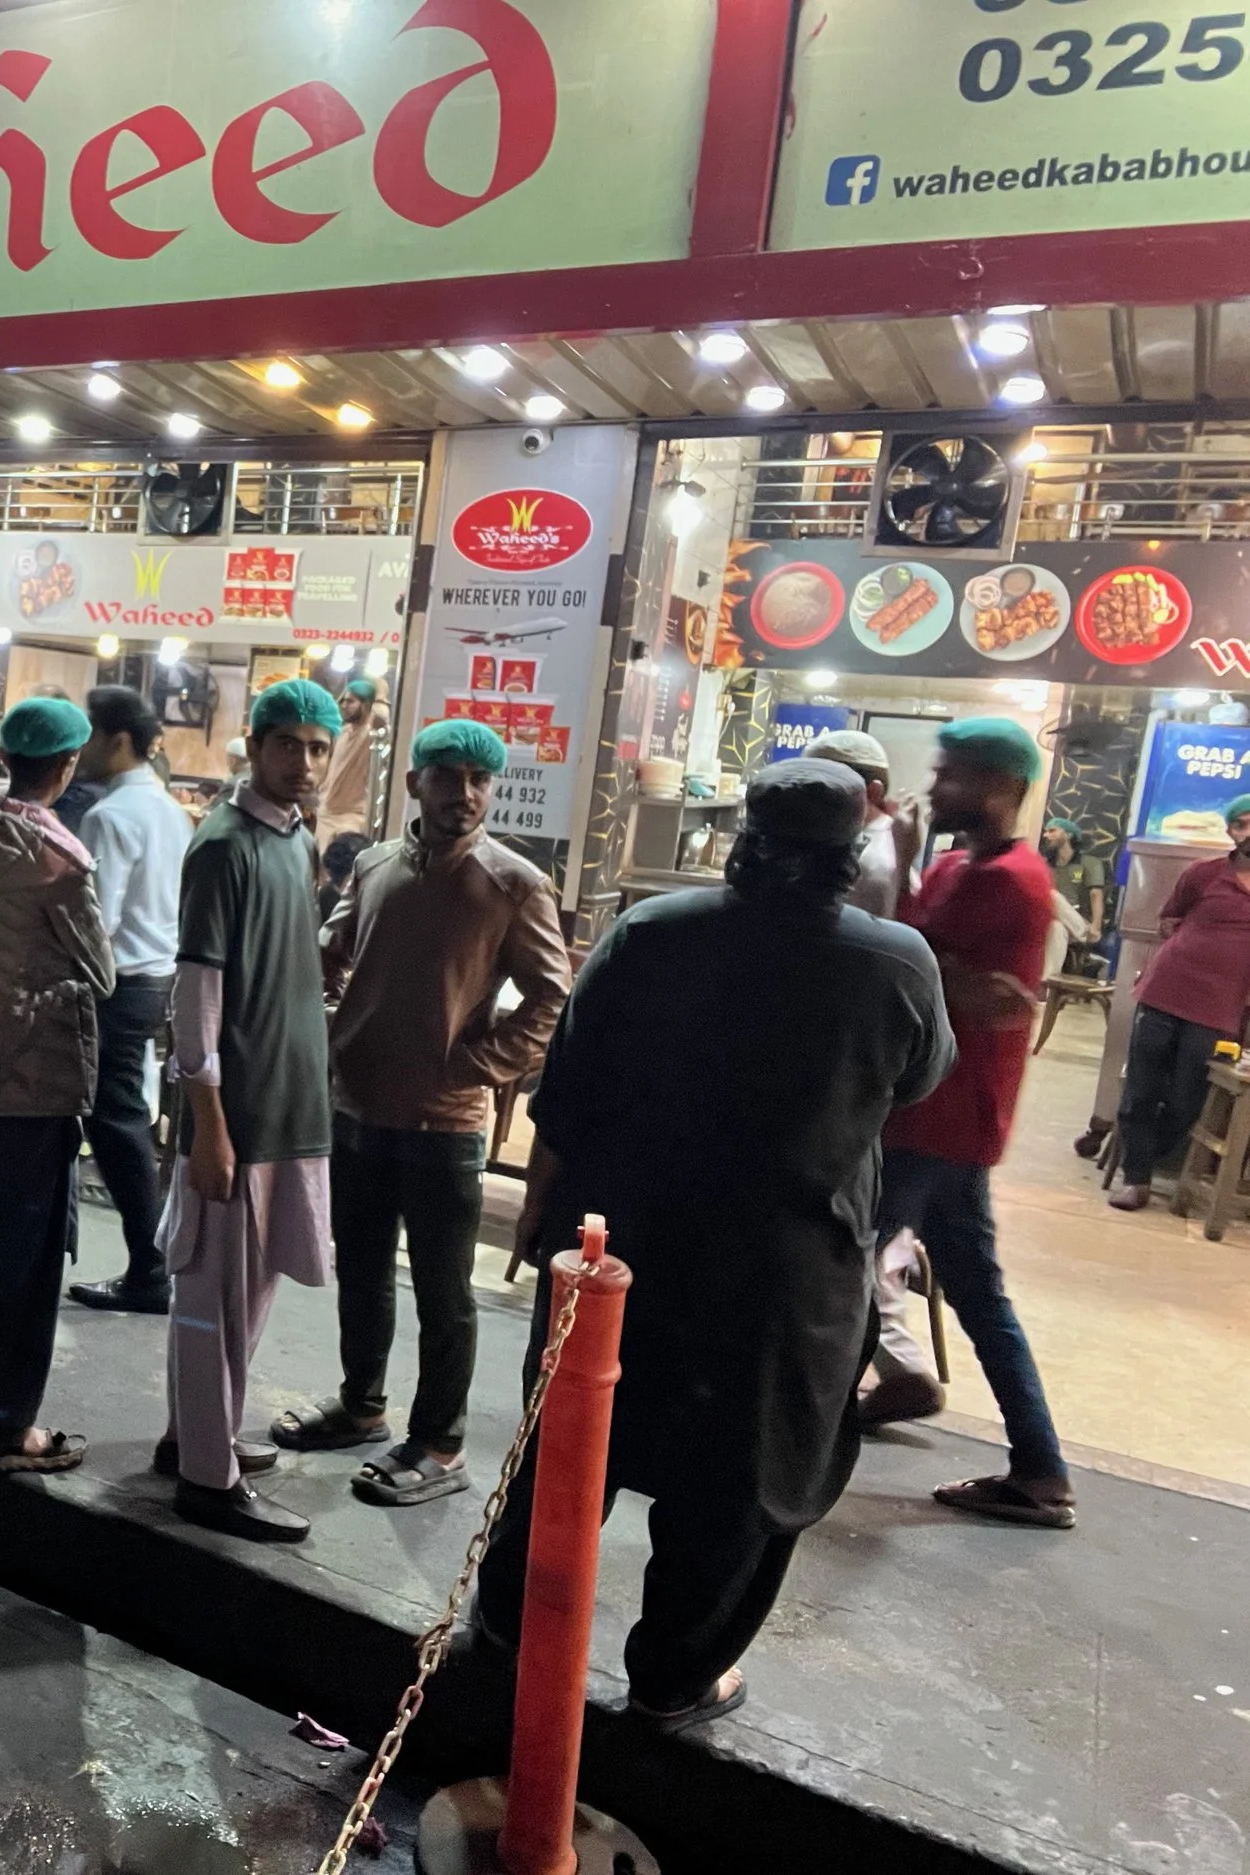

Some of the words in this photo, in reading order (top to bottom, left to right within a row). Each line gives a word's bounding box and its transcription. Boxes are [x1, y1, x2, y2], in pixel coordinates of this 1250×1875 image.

[958, 12, 1246, 103] 0325
[893, 147, 1250, 198] waheedkababhou
[442, 587, 520, 606] WHEREVER
[527, 589, 556, 607] YOU
[562, 590, 587, 608] GO!
[84, 601, 215, 627] Waheed
[1177, 744, 1235, 763] GRAB
[1186, 760, 1242, 779] PEPSI
[495, 785, 513, 801] 44
[519, 787, 546, 805] 932
[492, 809, 510, 825] 44
[516, 811, 543, 829] 499
